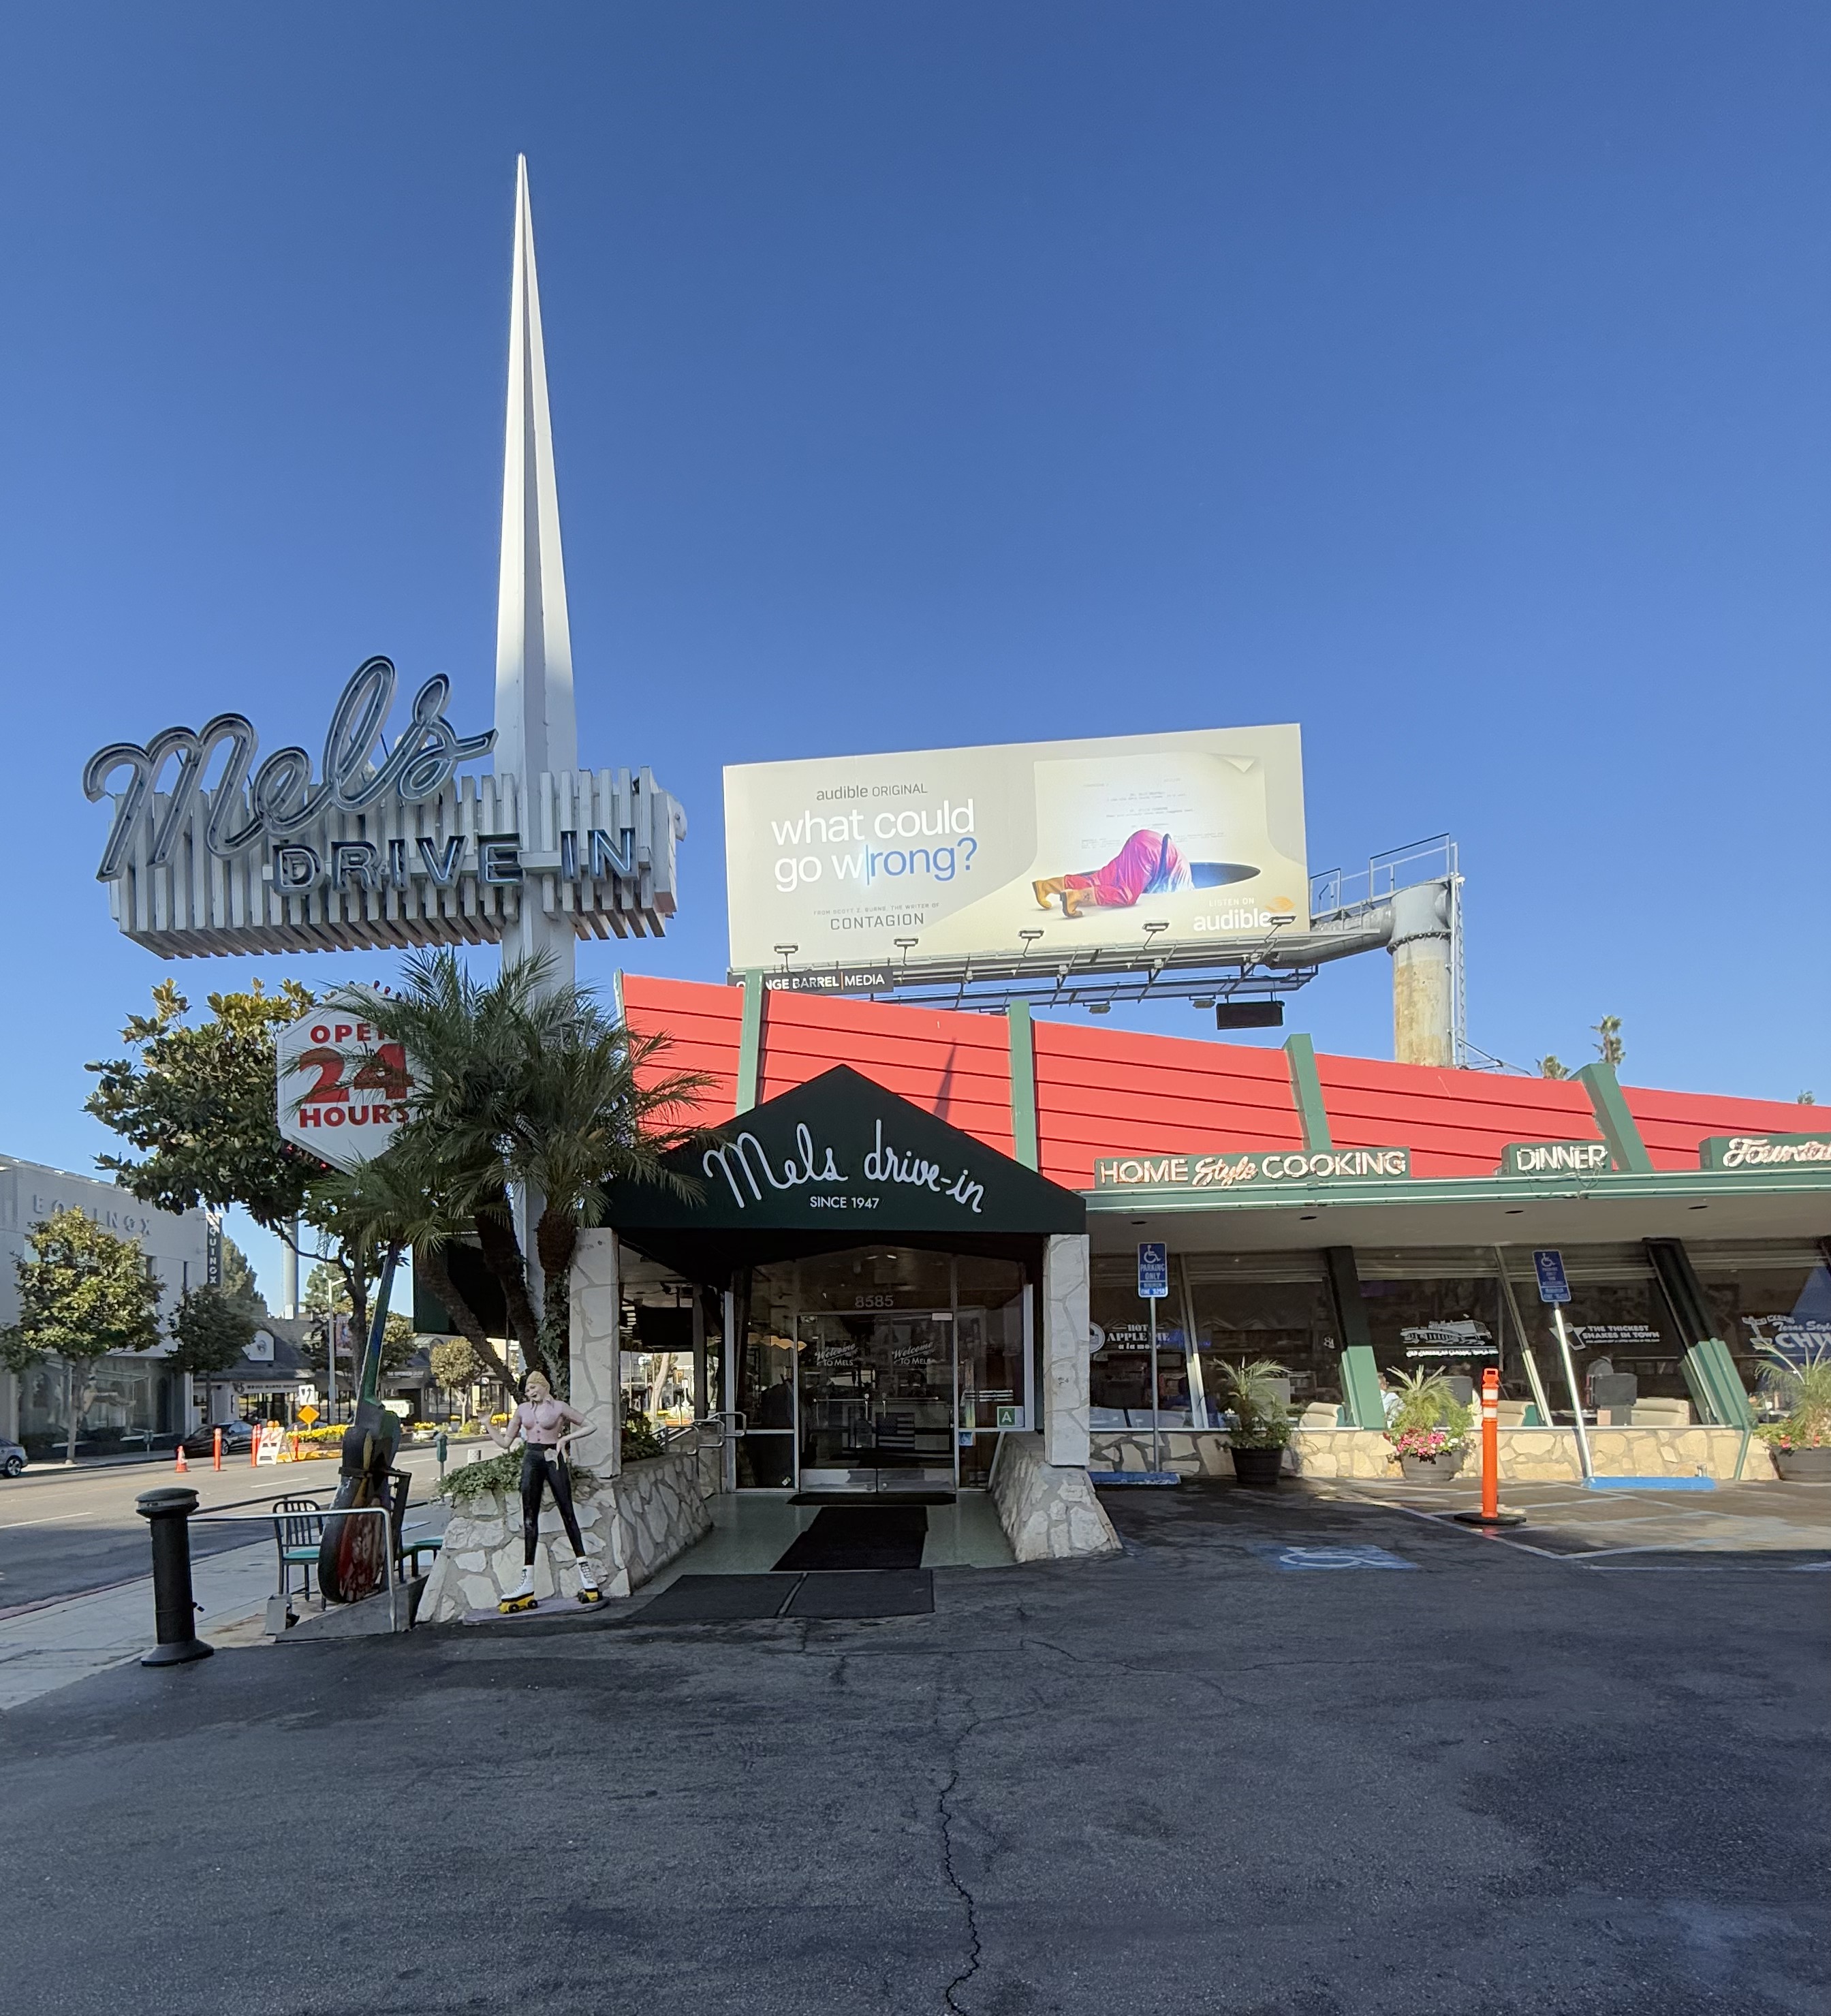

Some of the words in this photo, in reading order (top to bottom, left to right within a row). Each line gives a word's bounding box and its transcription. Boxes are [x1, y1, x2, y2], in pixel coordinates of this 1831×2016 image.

[816, 785, 868, 801] audible
[872, 784, 928, 798] ORIGINAL
[770, 809, 865, 845] what
[874, 798, 975, 839] could
[272, 833, 525, 896] DRIVE
[561, 827, 639, 884] IN
[774, 856, 822, 893] go
[1208, 898, 1239, 908] LISTEN
[1242, 897, 1255, 905] ON
[830, 913, 924, 931] CONTAGION
[1193, 908, 1272, 932] audible
[792, 976, 839, 989] BARREL
[844, 974, 885, 987] MEDIA
[299, 1042, 415, 1104] 24
[703, 1123, 848, 1208] Mels
[864, 1119, 985, 1213] drive-in
[1516, 1145, 1608, 1171] DINNER
[1100, 1158, 1189, 1184] HOME
[1192, 1156, 1258, 1186] Style
[1262, 1151, 1407, 1179] COOKING
[809, 1196, 847, 1209] SINCE
[851, 1196, 880, 1209] 1947
[1144, 1272, 1161, 1280] ONLY
[854, 1294, 894, 1307] 8585
[1107, 1332, 1148, 1342] APPLE
[1149, 1332, 1170, 1341] IE
[815, 1343, 856, 1361] Welcome
[892, 1341, 934, 1360] Welcome
[1001, 1411, 1012, 1423] A
